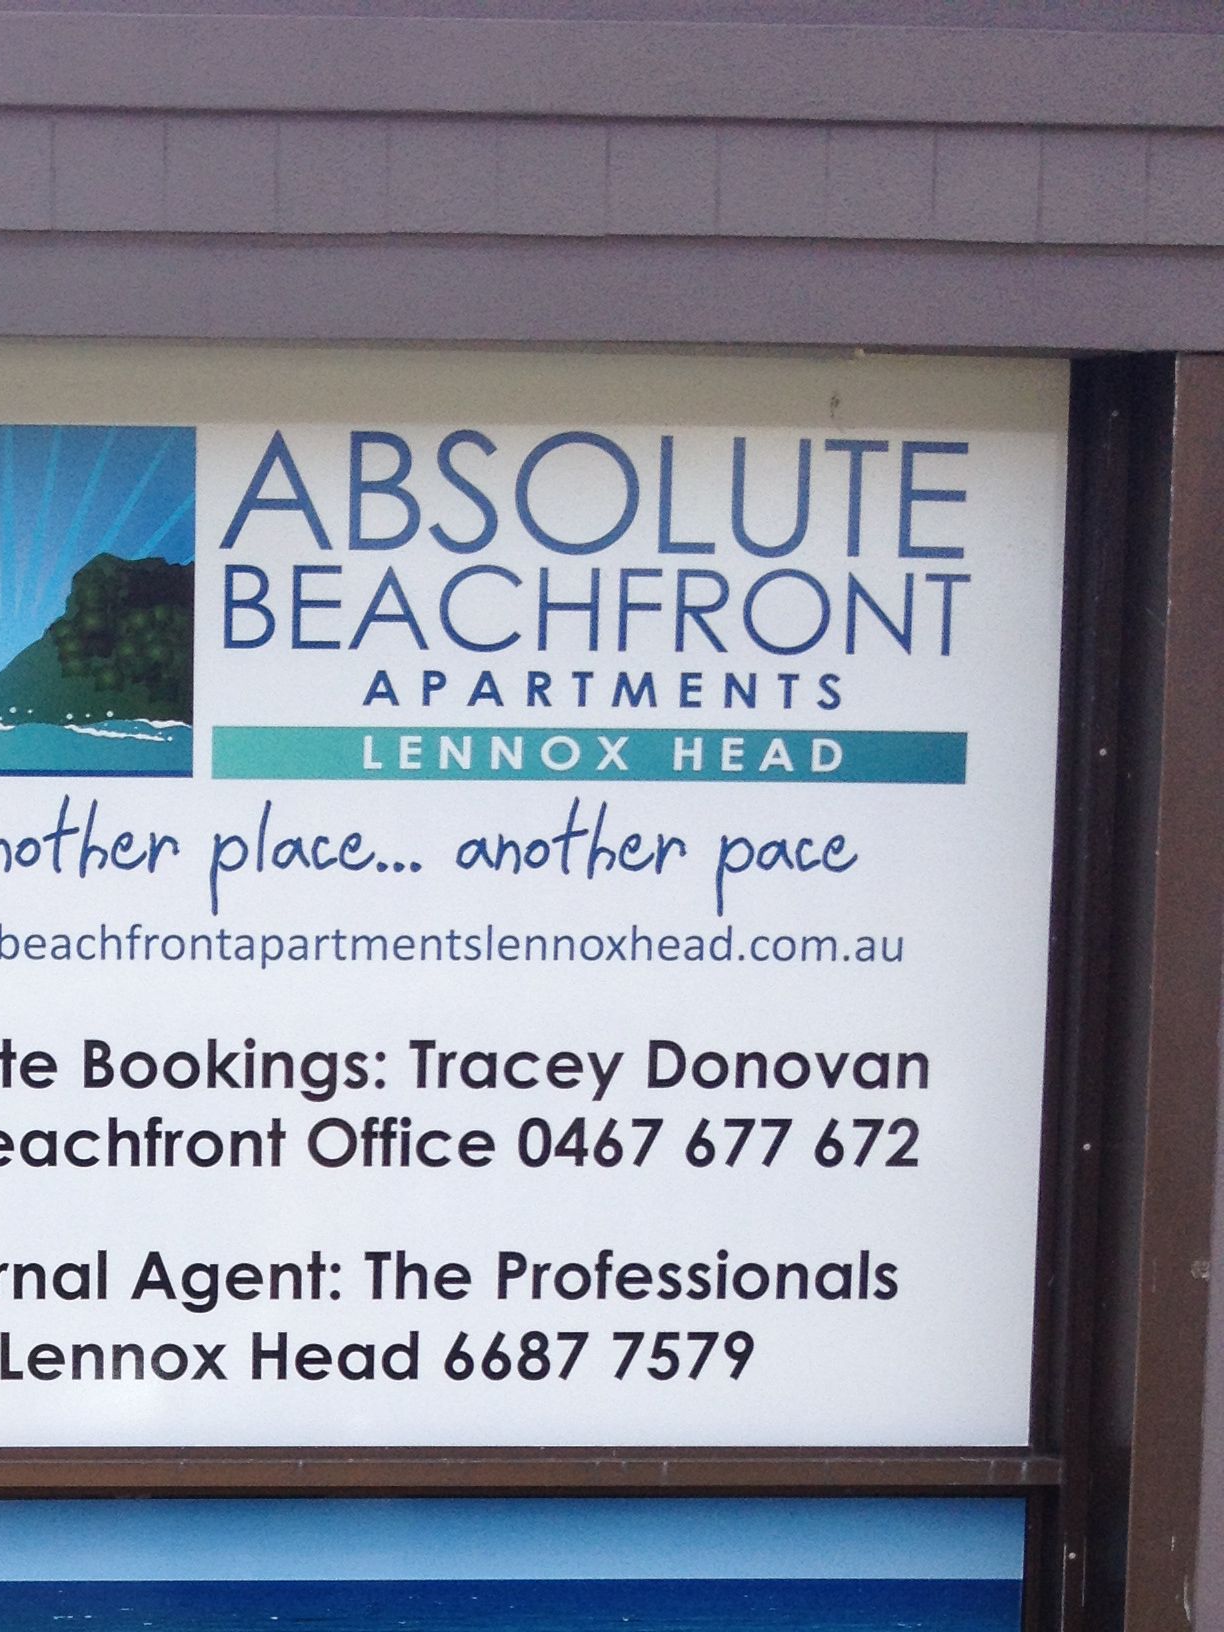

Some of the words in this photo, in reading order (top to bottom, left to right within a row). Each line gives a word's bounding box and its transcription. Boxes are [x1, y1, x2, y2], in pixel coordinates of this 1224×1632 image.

[219, 429, 969, 559] ABSOLUTE
[224, 564, 972, 657] BEACHFRONT
[362, 669, 843, 711] APARTMENTS
[362, 734, 630, 772] LENNOX
[672, 736, 844, 773] HEAD
[209, 799, 422, 917] place...
[455, 796, 687, 880] another
[715, 834, 859, 918] pace
[84, 1037, 386, 1103] Bookings:
[409, 1039, 624, 1101] Tracey
[647, 1039, 929, 1090] Donovan
[308, 1116, 495, 1168] Office
[518, 1117, 664, 1168] 0467
[685, 1117, 793, 1168] 677
[814, 1117, 919, 1168] 672
[131, 1250, 341, 1313] Agent:
[364, 1250, 472, 1300] The
[497, 1249, 898, 1300] Professionals
[0, 1332, 228, 1381] Lennox
[252, 1330, 419, 1381] Head
[444, 1331, 589, 1381] 6687
[613, 1330, 755, 1381] 7579
